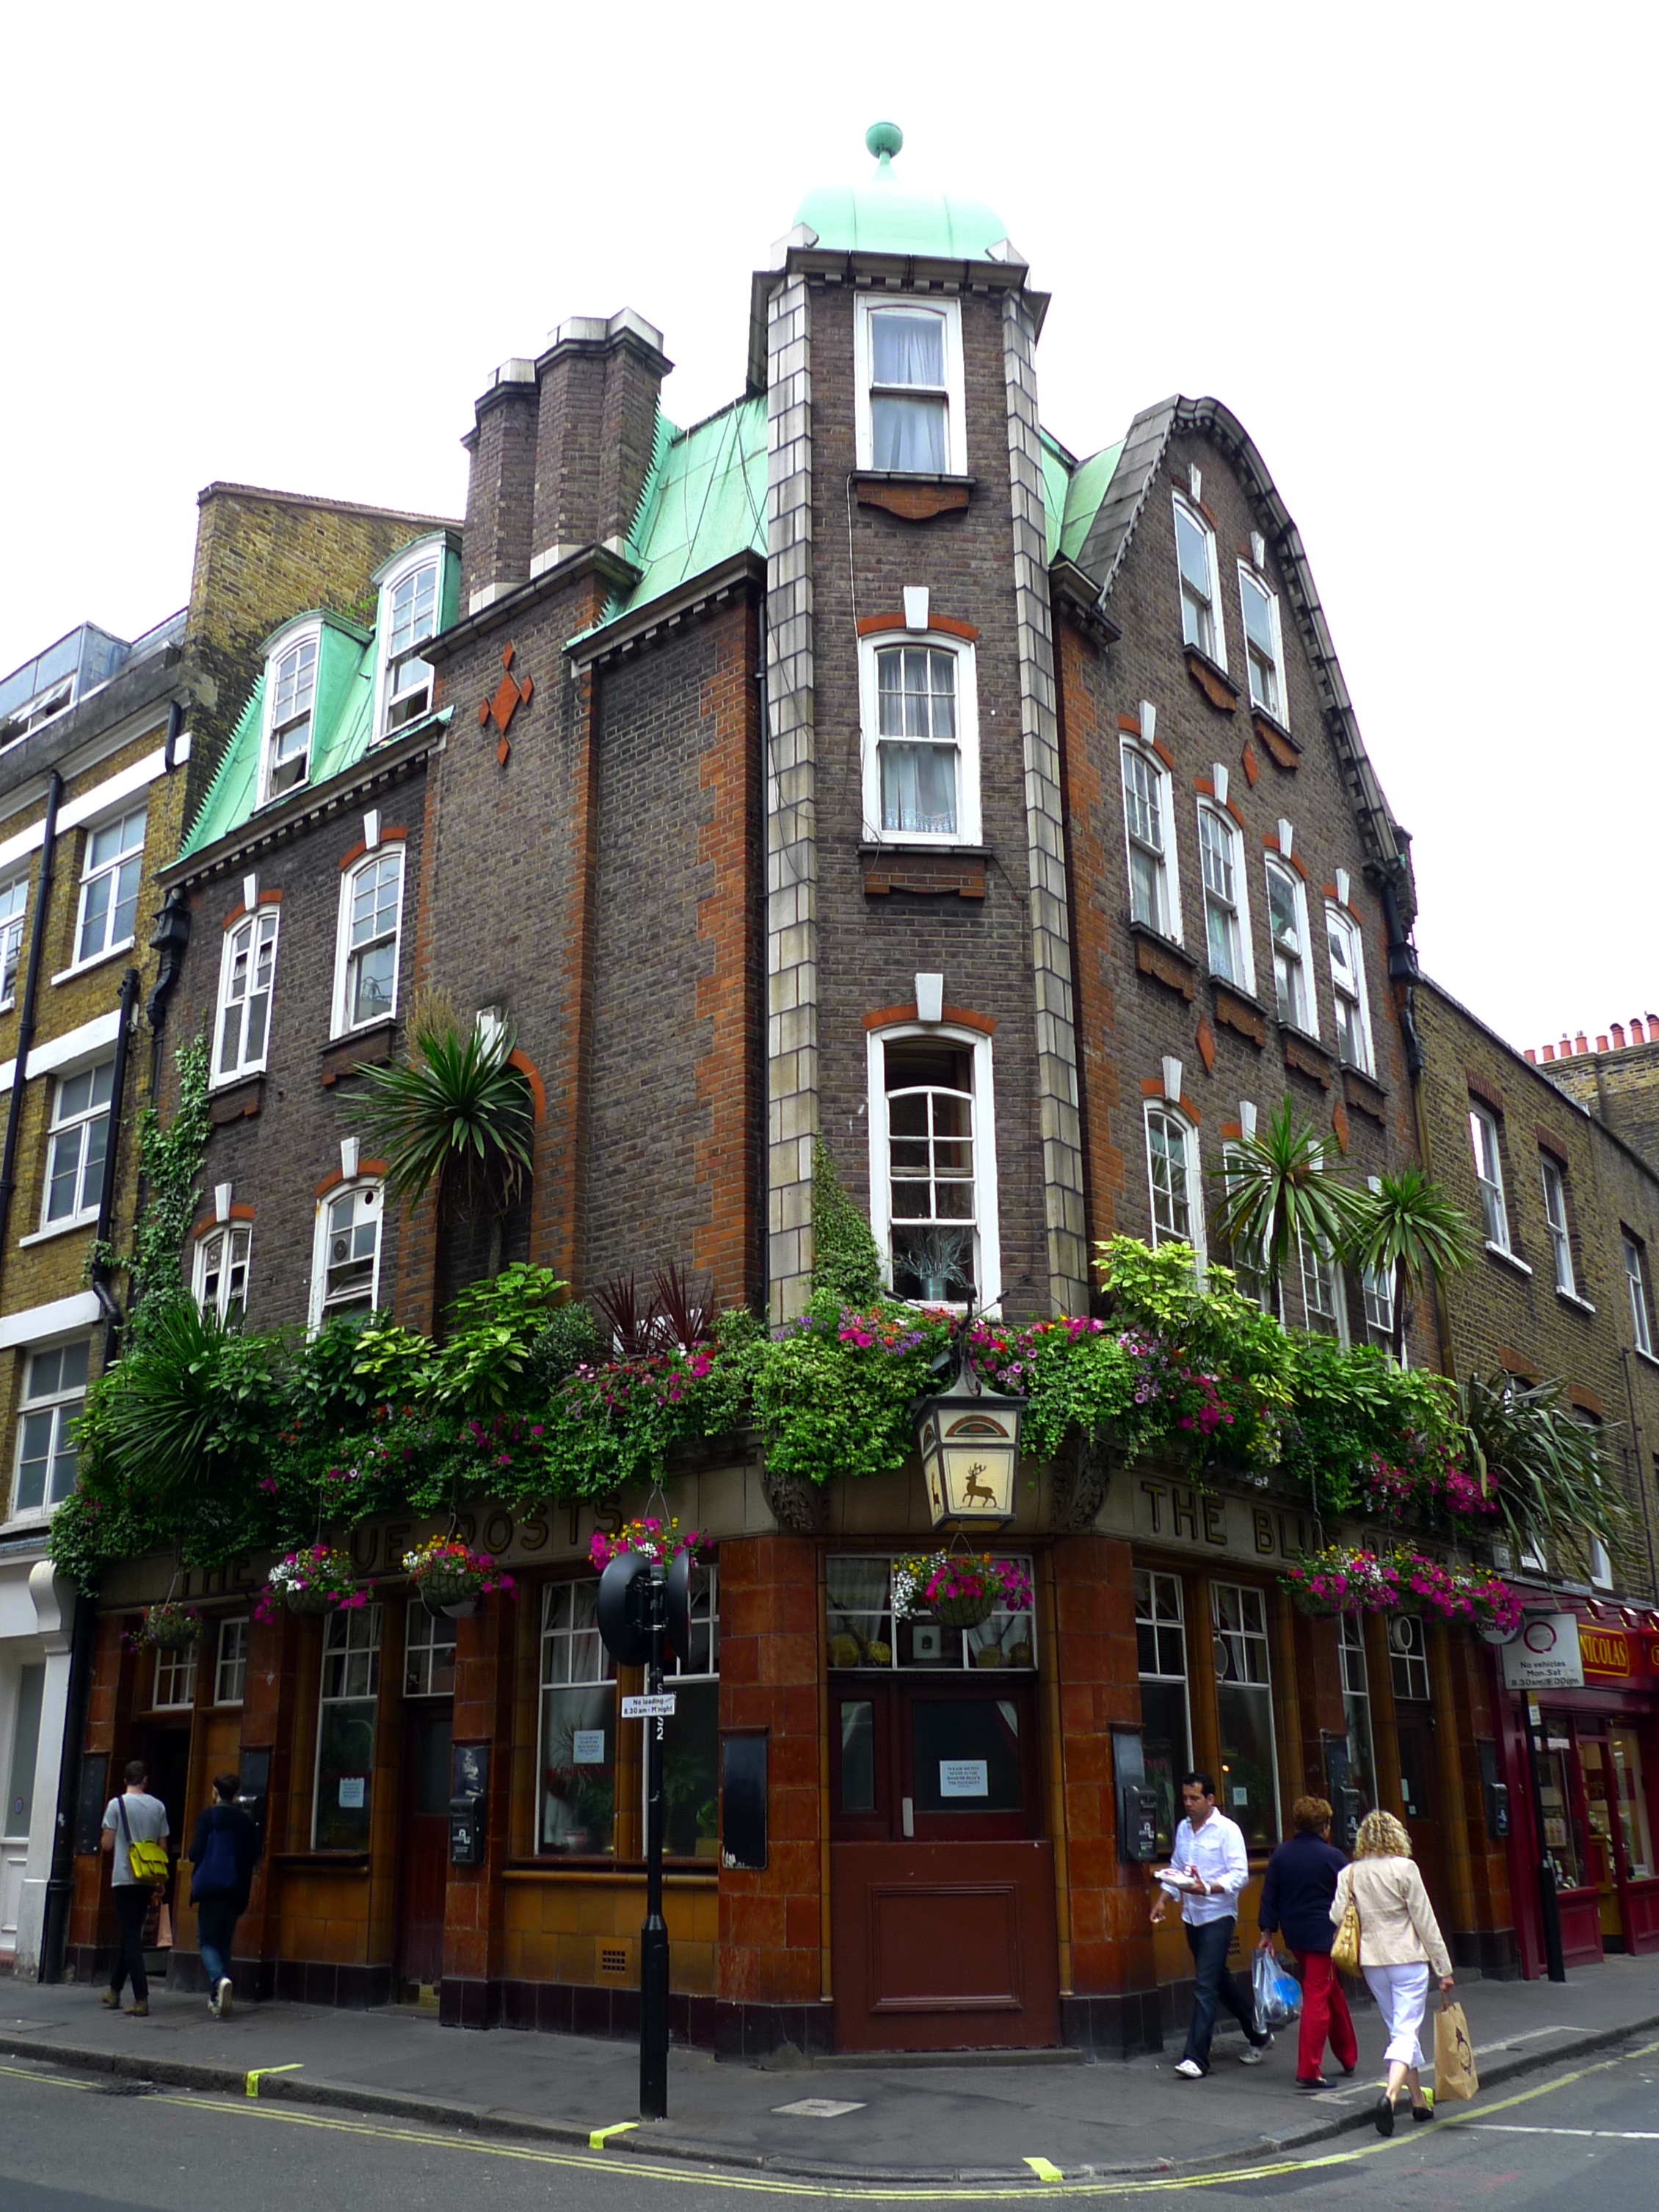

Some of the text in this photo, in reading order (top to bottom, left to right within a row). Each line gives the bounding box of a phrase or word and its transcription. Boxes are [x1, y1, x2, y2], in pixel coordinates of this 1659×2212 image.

[1141, 1480, 1227, 1545] THE
[1533, 1660, 1566, 1668] vehicles
[1579, 1634, 1626, 1667] NICOLAS
